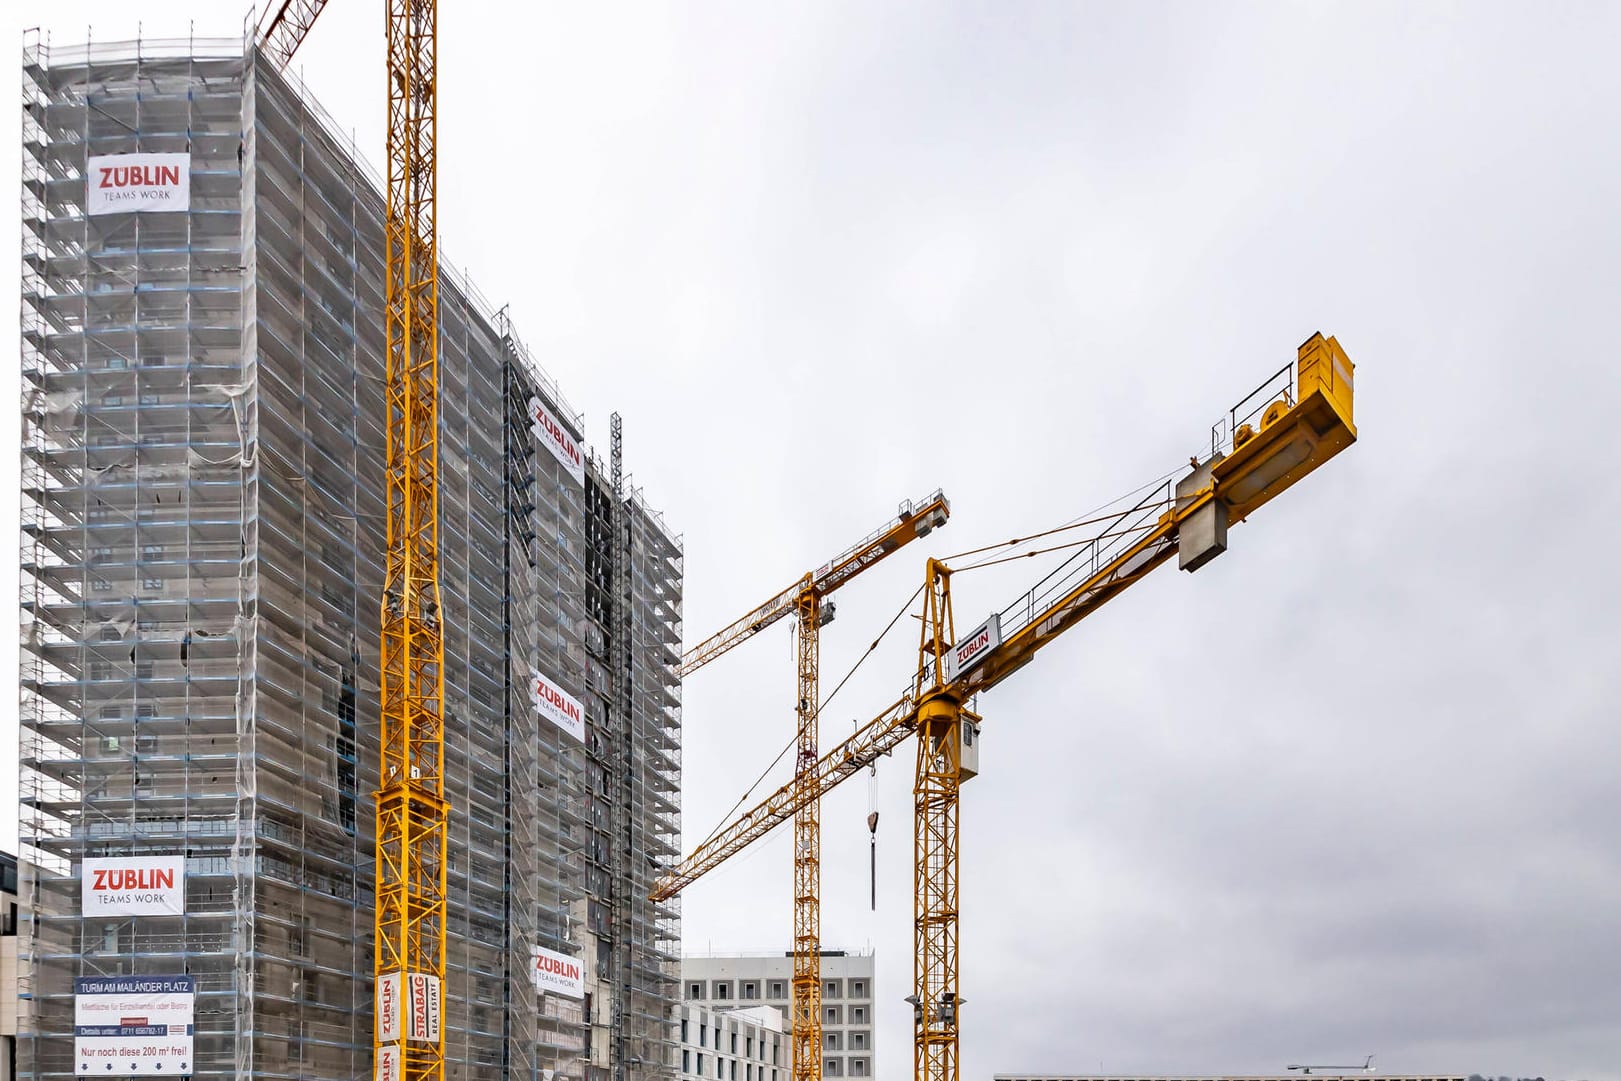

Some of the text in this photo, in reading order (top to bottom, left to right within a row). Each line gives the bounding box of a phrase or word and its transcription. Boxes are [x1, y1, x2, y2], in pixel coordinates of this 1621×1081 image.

[99, 165, 179, 188] ZÜBLIN
[104, 190, 171, 201] TEAMS WORK
[537, 680, 580, 723] ZÜBLIN
[92, 868, 174, 890] ZÜBLIN
[98, 893, 165, 904] TEAMS WORK
[536, 954, 580, 980] ZÜBLIN
[81, 980, 188, 993] TURM AM MAILÄNDER PLATZ
[538, 972, 575, 988] TEAMS WORK
[414, 976, 426, 1038] STRABAG
[81, 1047, 96, 1057] Nur
[97, 1047, 117, 1057] noch
[119, 1046, 141, 1056] diese
[142, 1046, 157, 1056] 200
[171, 1045, 187, 1056] frei!
